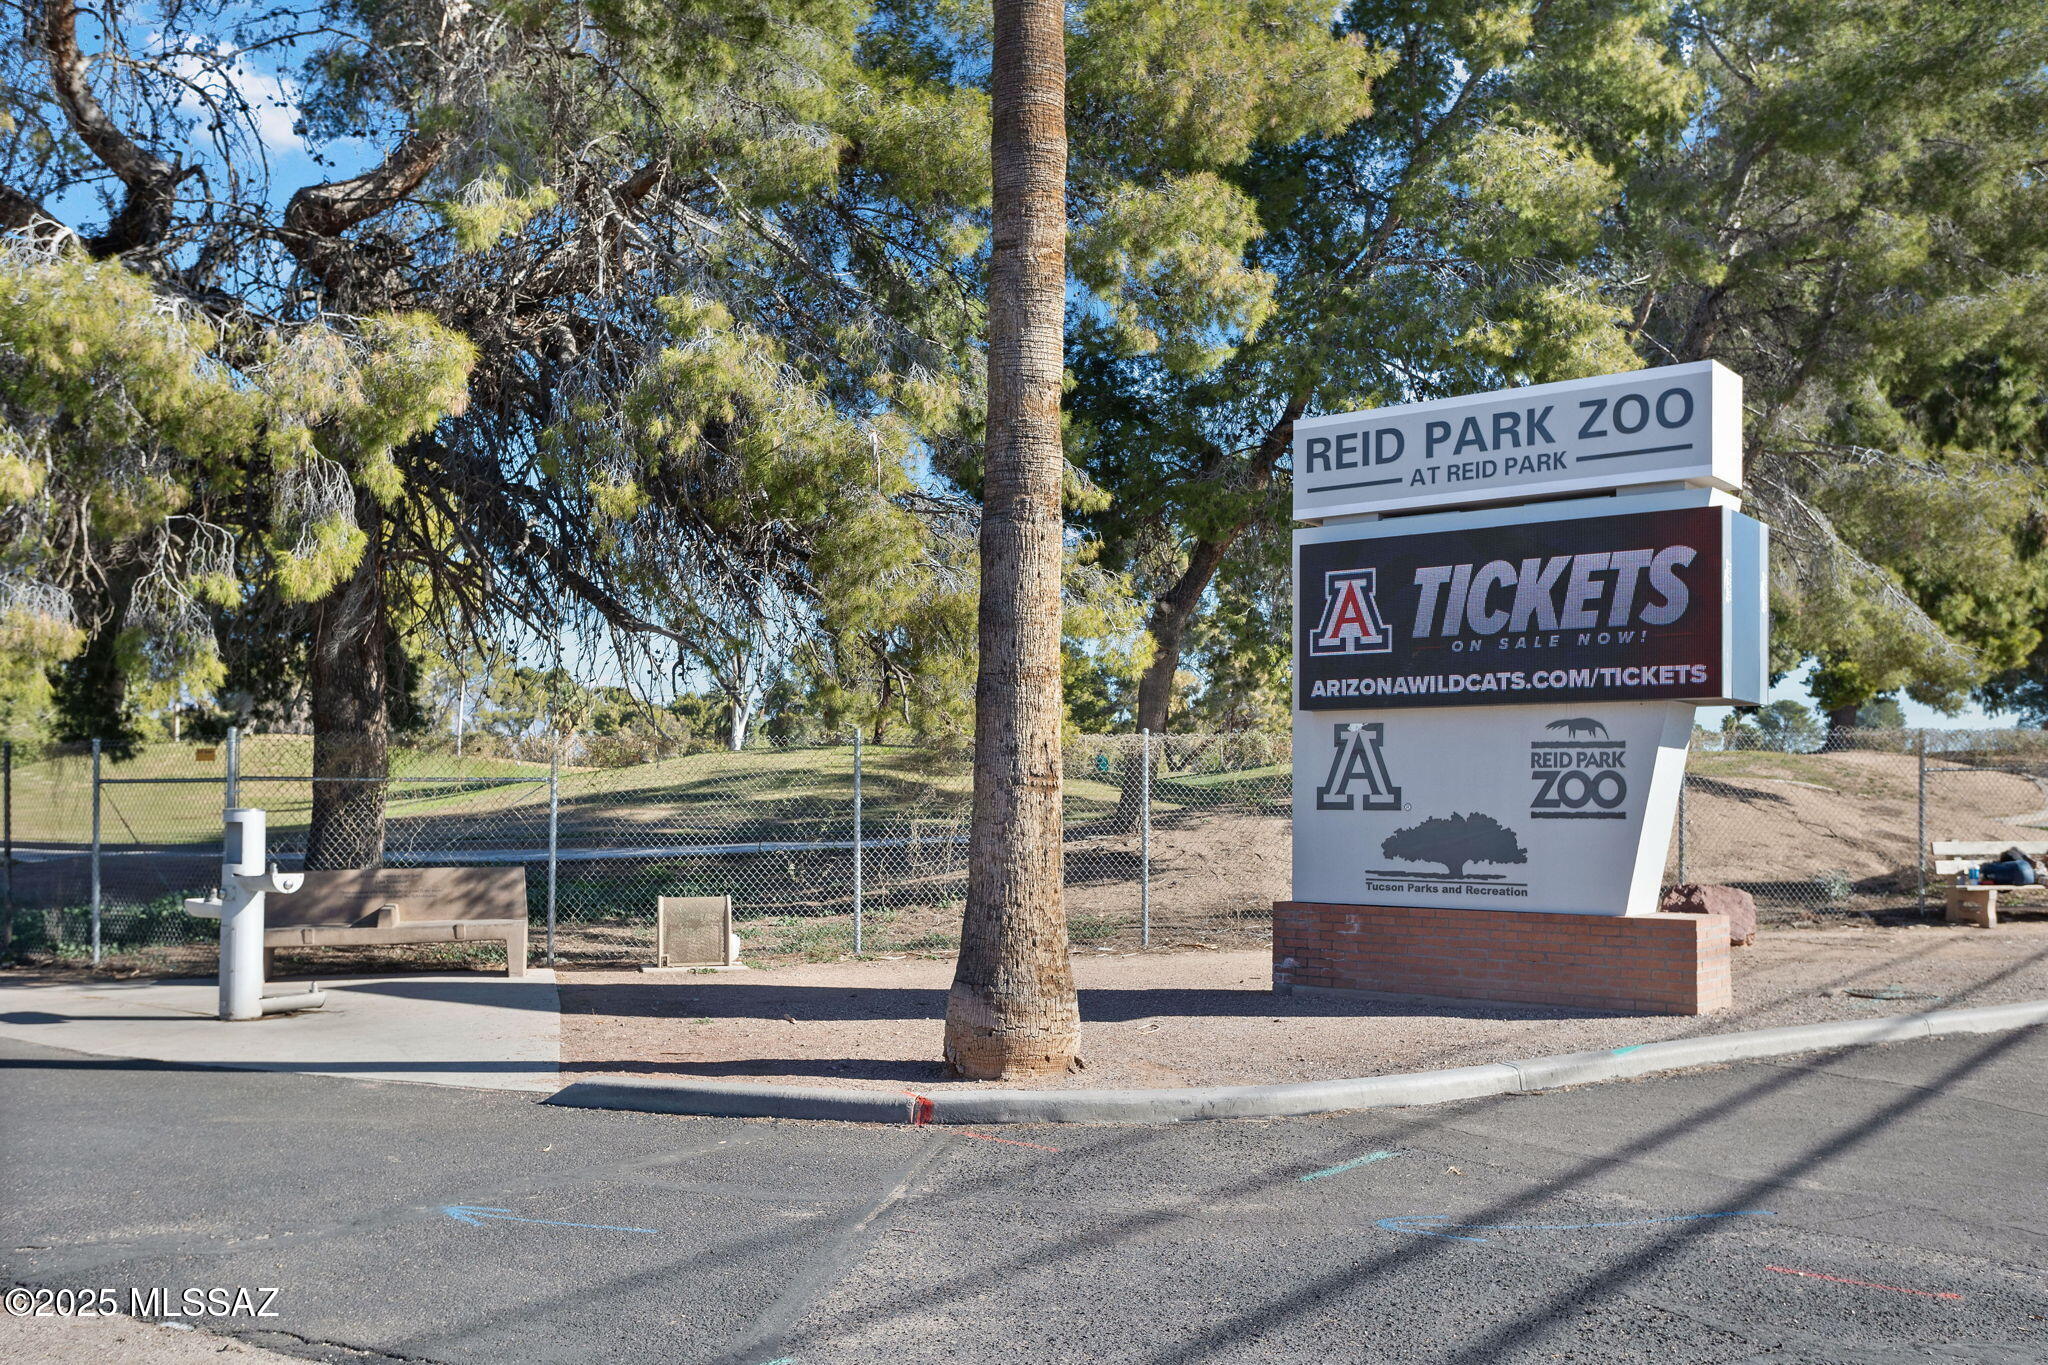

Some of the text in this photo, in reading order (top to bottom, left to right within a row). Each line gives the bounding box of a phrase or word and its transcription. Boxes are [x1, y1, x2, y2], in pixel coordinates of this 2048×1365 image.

[1306, 387, 1695, 474] REID PARK ZOO
[1409, 451, 1568, 487] AT REID PARK
[1411, 544, 1698, 640] TICKETS
[1450, 630, 1648, 654] ON SALE NOW!
[1311, 664, 1708, 698] ARIZONAWILDCATS.COM/TICKETS
[1530, 750, 1627, 769] REID PARK
[1530, 769, 1628, 809] ZOO
[1365, 881, 1529, 897] Tucson Parks and Recreation
